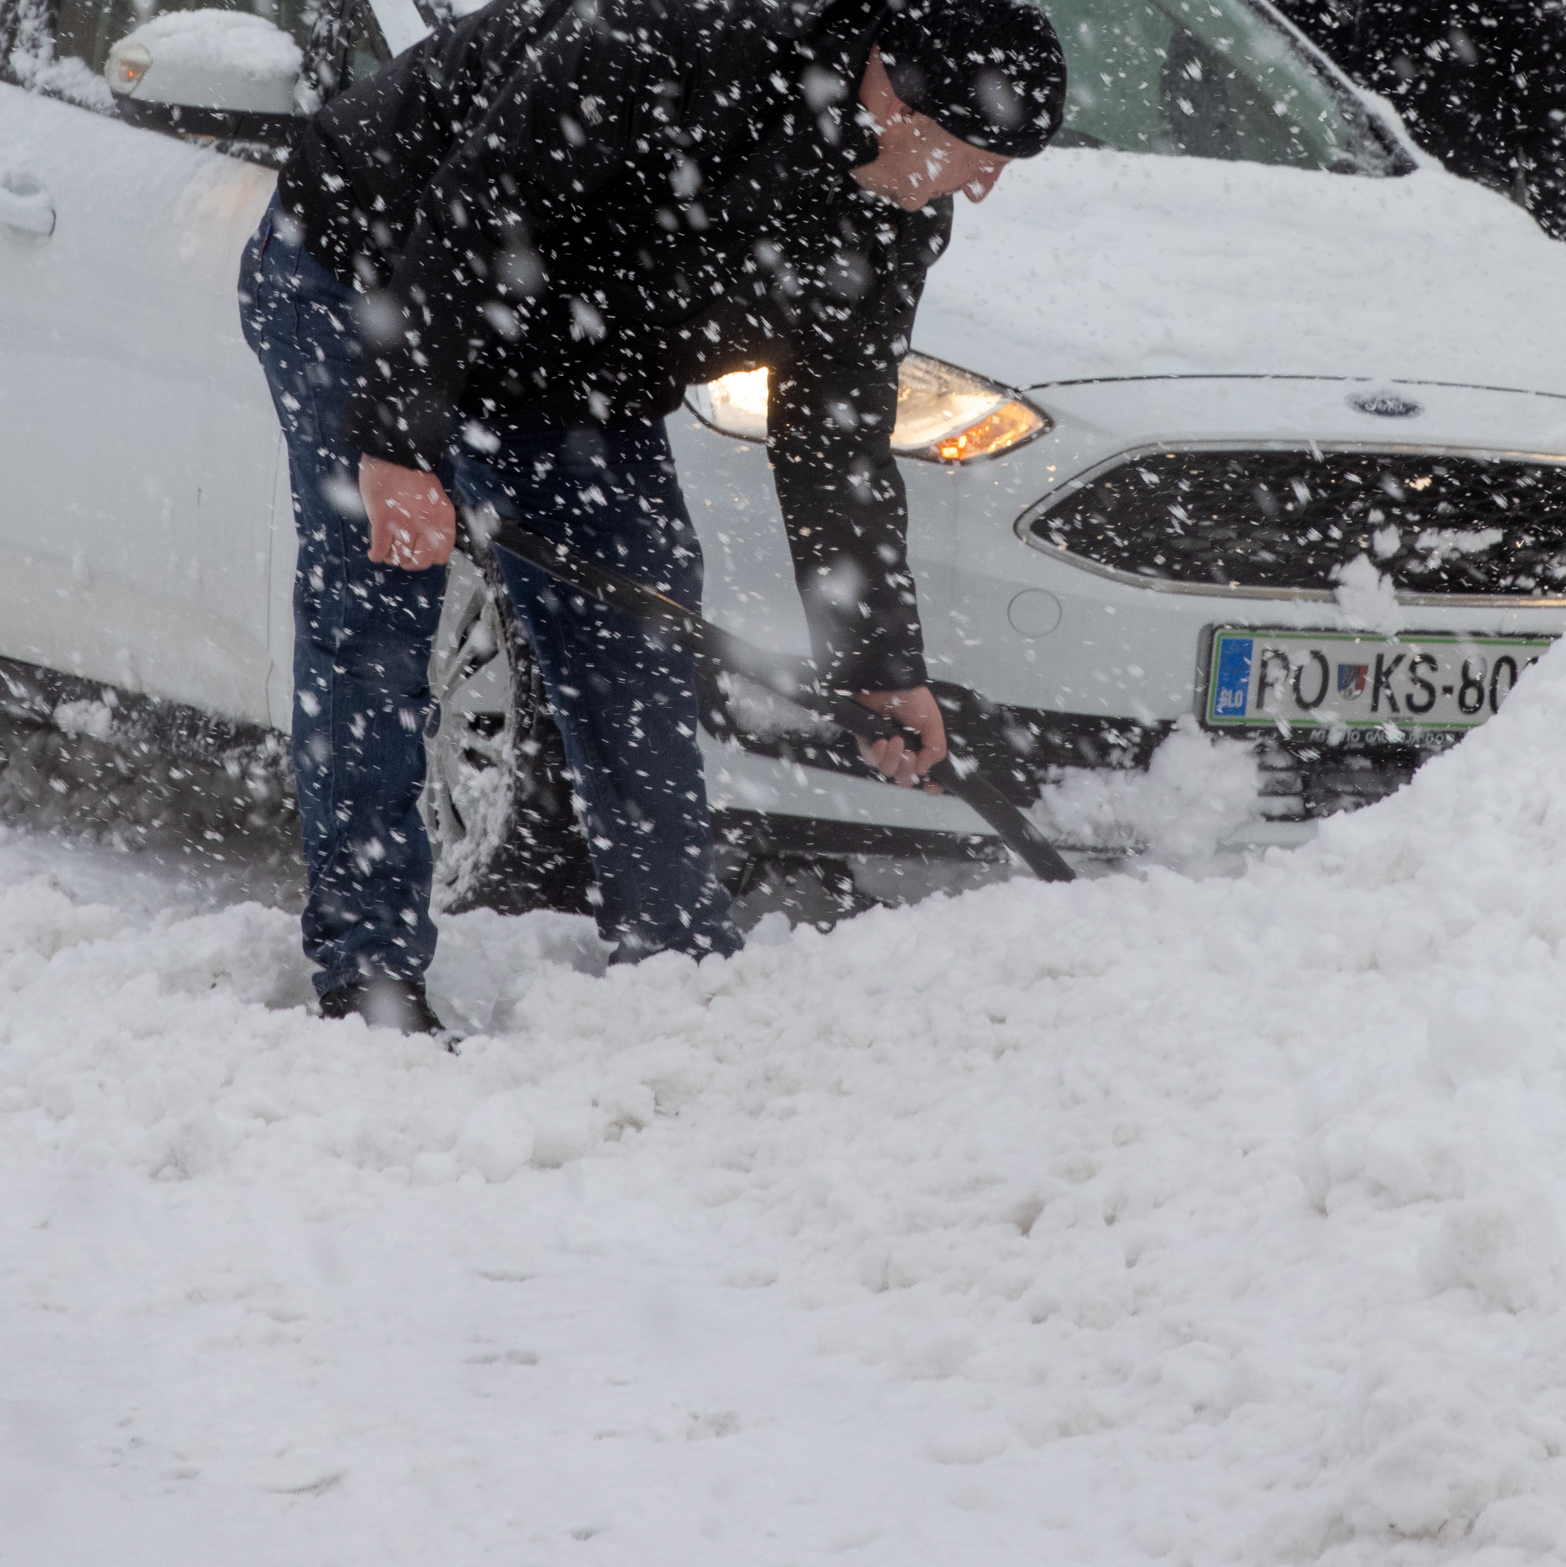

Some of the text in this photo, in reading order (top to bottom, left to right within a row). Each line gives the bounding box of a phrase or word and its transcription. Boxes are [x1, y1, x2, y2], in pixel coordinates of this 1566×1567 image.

[1218, 687, 1244, 709] SLO
[1256, 648, 1539, 715] PO KS-80
